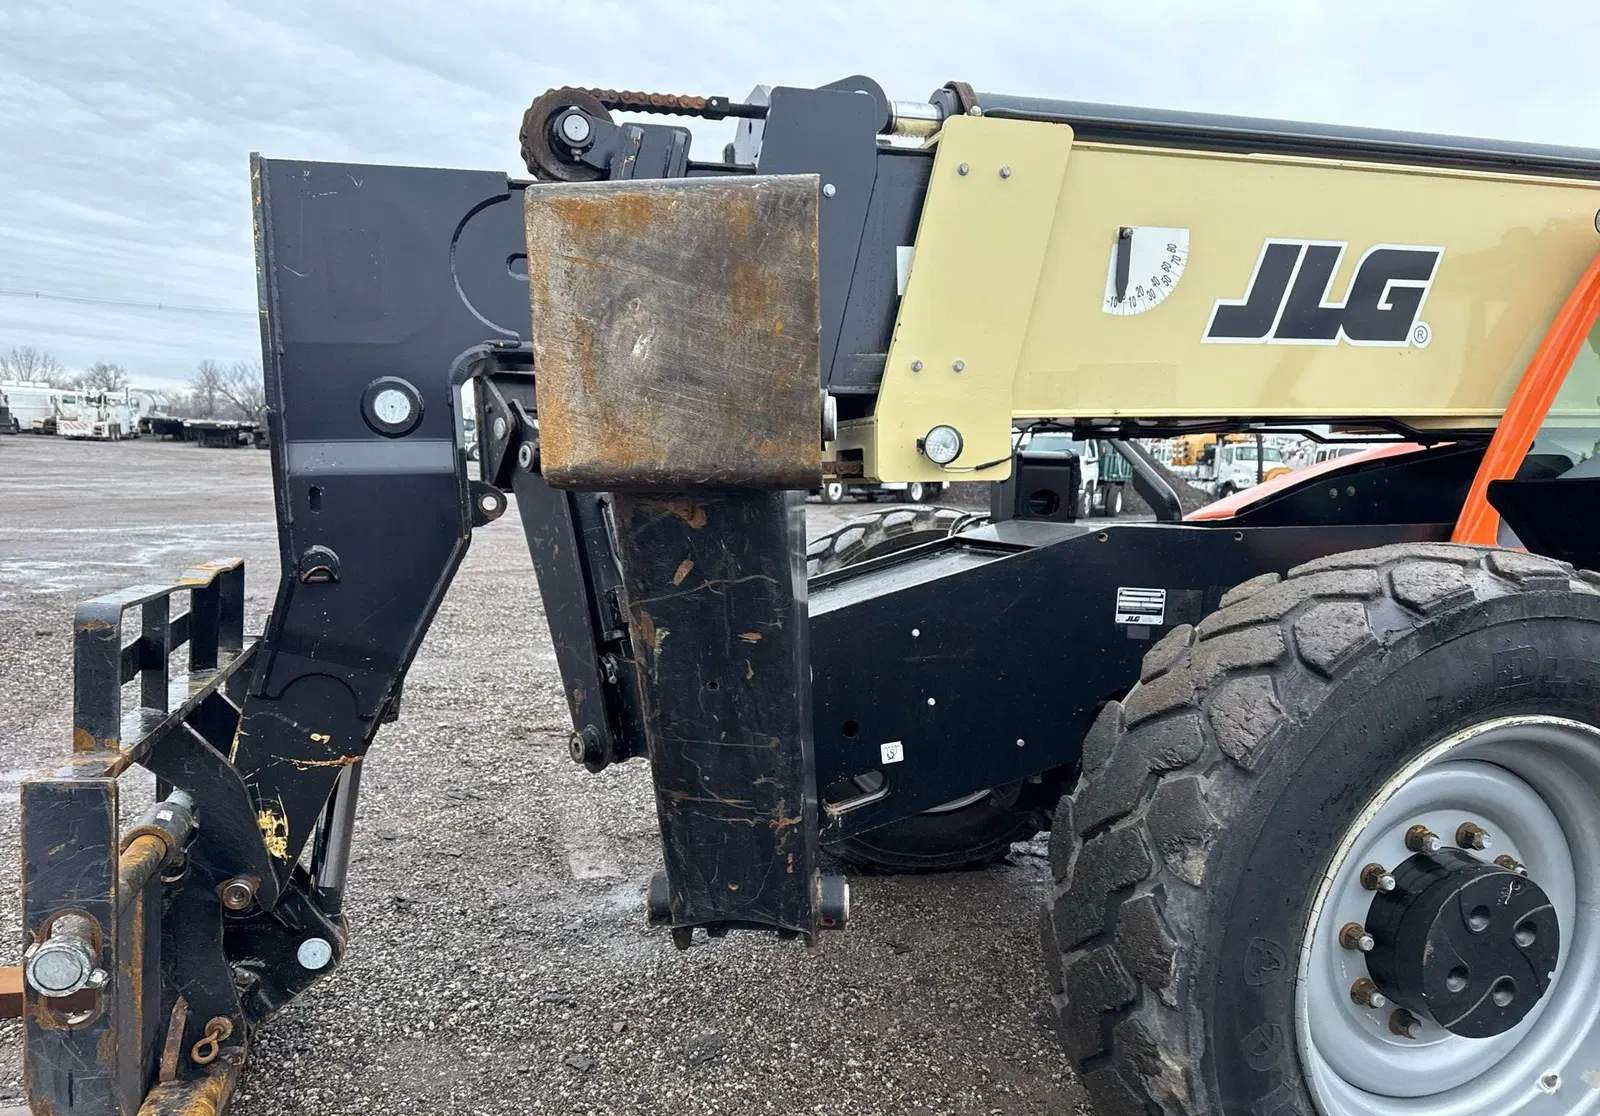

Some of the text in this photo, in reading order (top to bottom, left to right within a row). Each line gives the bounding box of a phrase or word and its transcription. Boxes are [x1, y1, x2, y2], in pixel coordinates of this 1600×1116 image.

[1166, 243, 1177, 253] 80
[1161, 261, 1172, 272] 60
[1171, 255, 1181, 266] 70
[1151, 276, 1160, 287] 40
[1161, 275, 1172, 287] 50
[1135, 285, 1145, 298] 20
[1146, 288, 1156, 301] 30
[1205, 241, 1442, 343] JLG
[1129, 296, 1137, 308] 10
